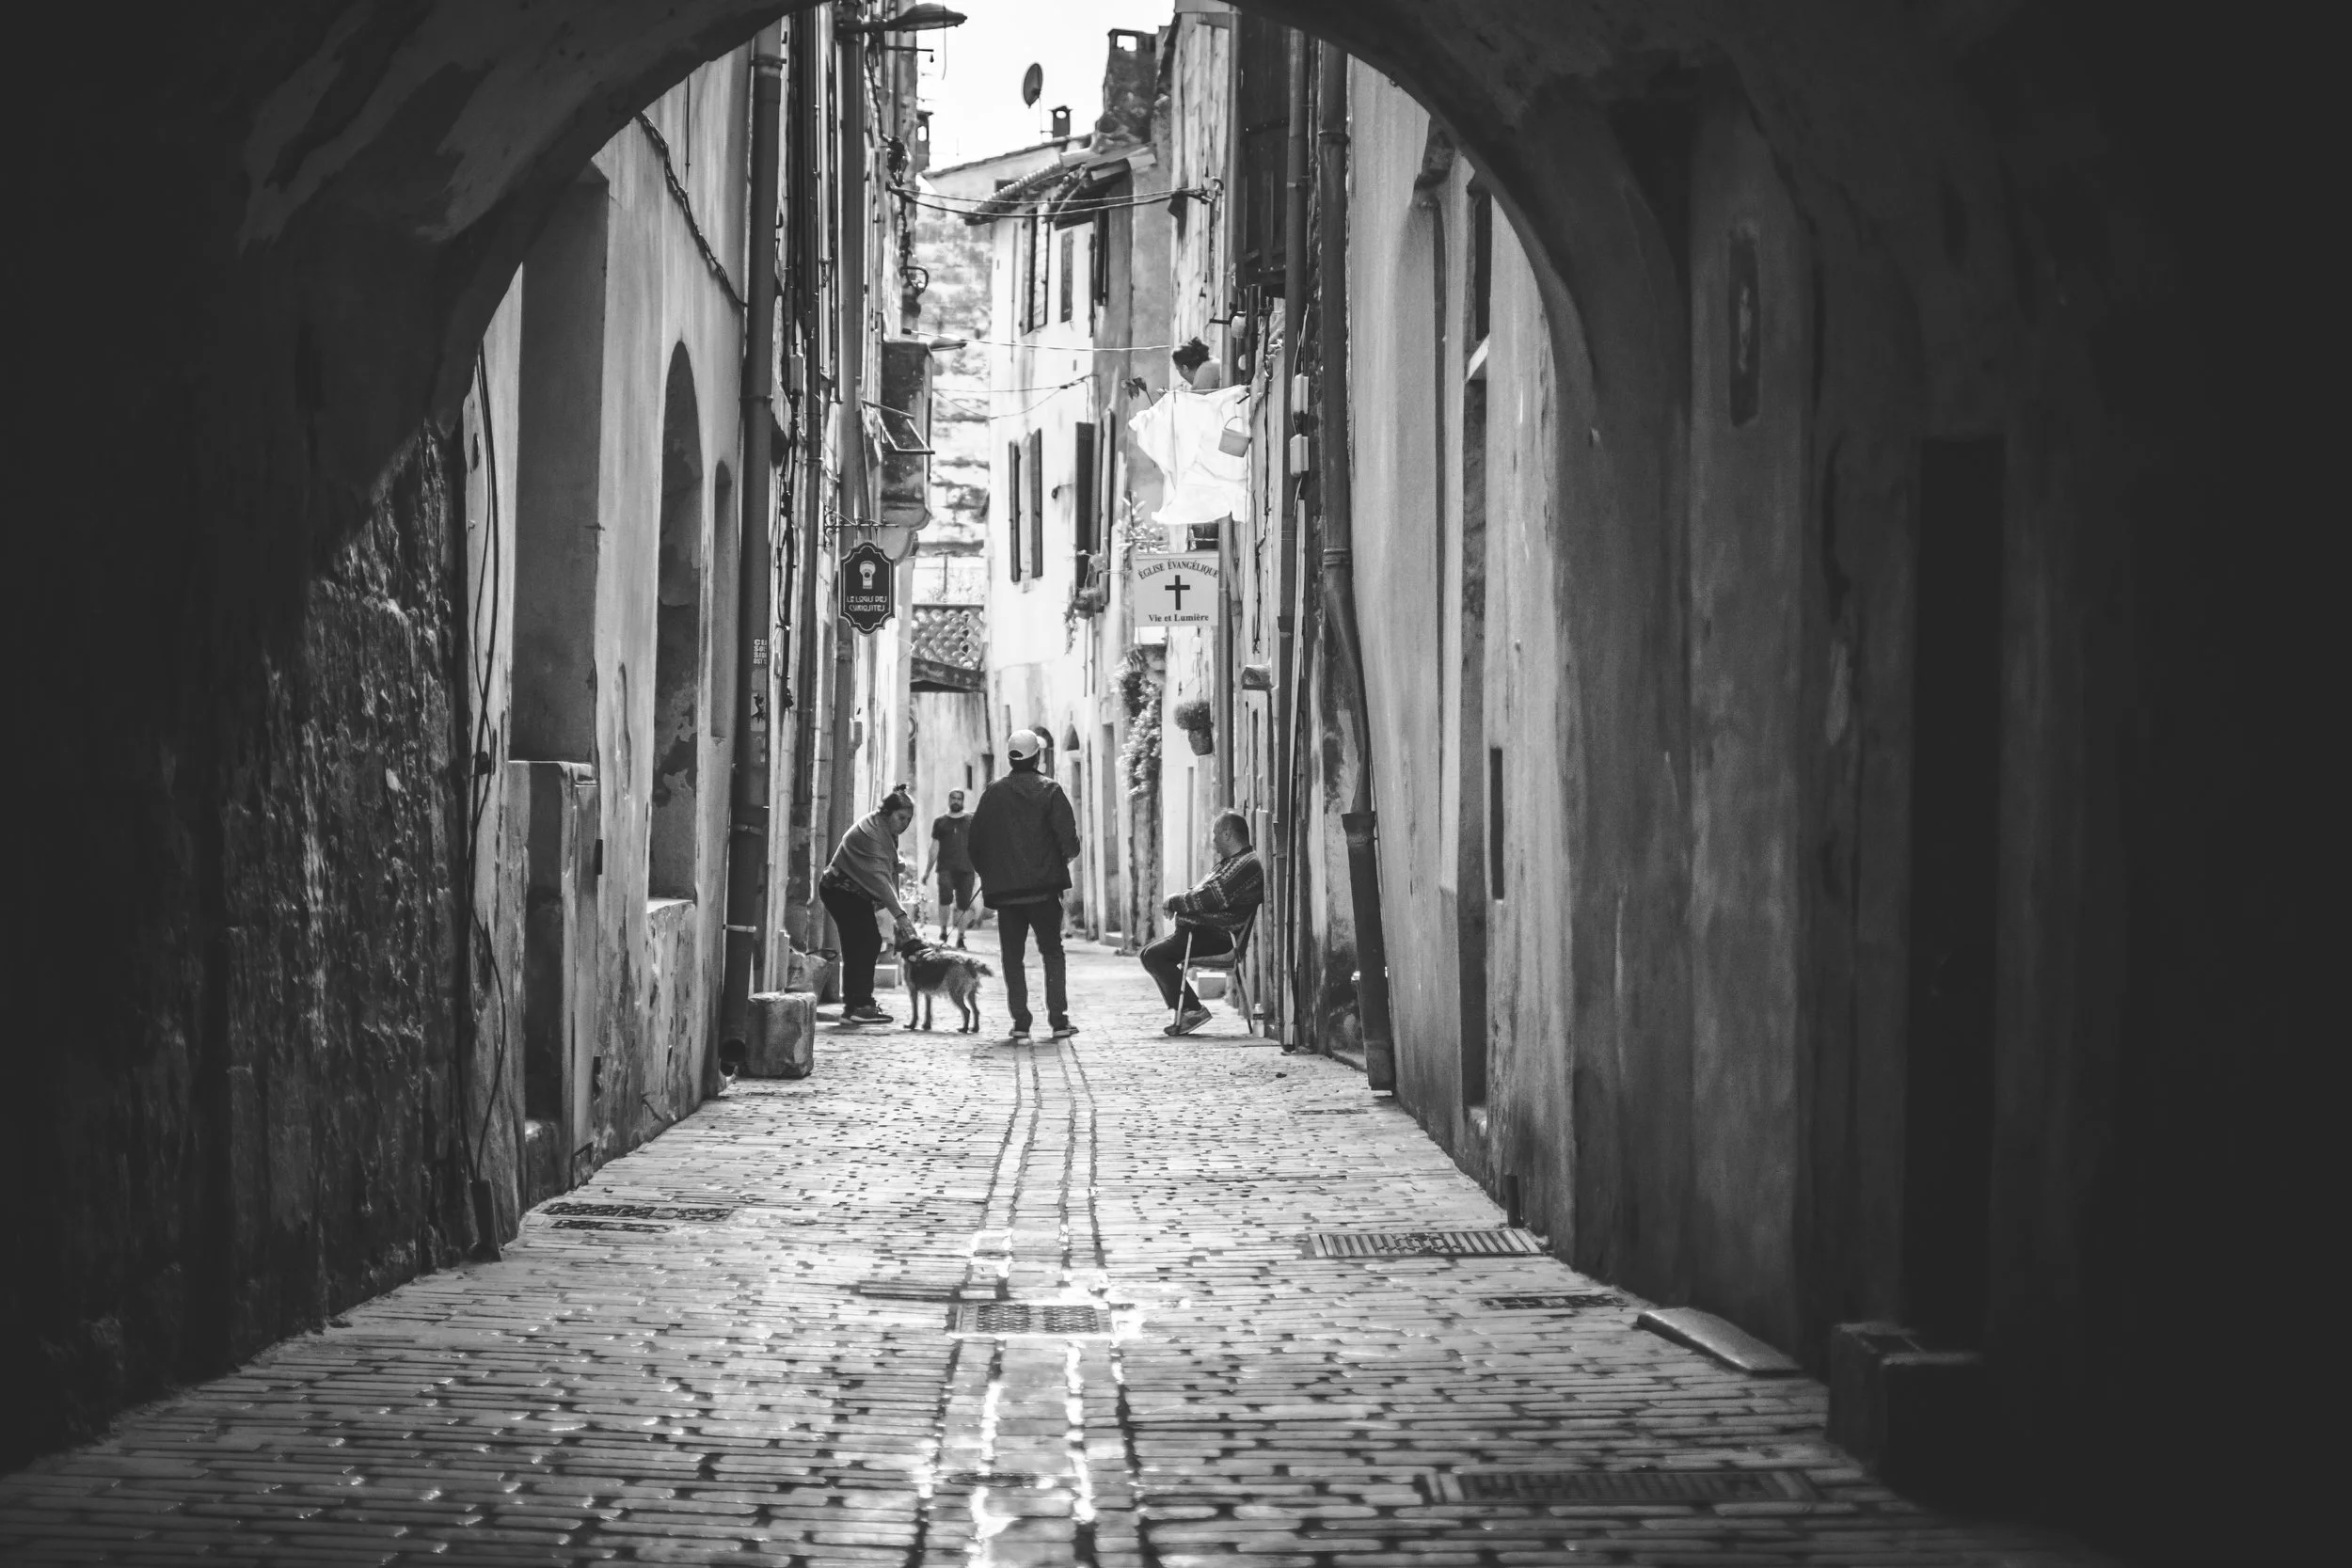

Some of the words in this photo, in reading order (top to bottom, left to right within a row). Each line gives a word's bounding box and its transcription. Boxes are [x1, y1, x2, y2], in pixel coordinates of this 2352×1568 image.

[1137, 562, 1165, 579] ÉGLISE
[1168, 559, 1219, 578] ÉVANGÉLIQUE
[1174, 613, 1209, 622] Lumière
